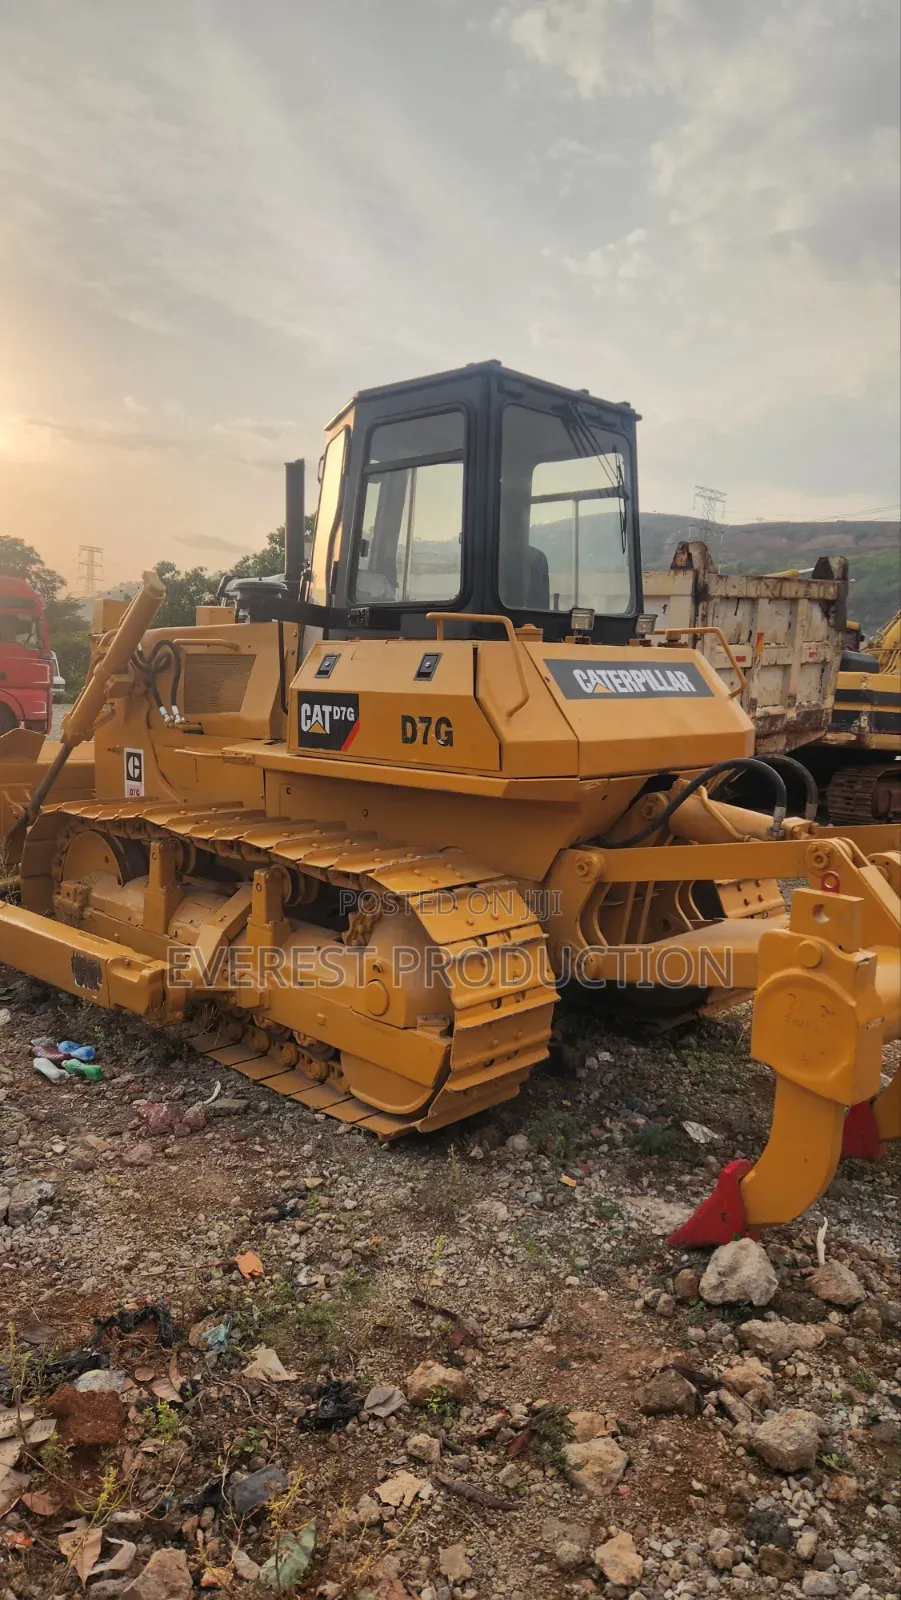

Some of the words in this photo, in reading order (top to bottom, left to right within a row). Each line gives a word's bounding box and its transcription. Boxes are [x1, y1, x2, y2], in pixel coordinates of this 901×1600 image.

[573, 669, 697, 694] CATERPILLAR
[301, 703, 332, 735] CAT
[333, 706, 355, 722] D7G
[401, 715, 454, 747] D7G
